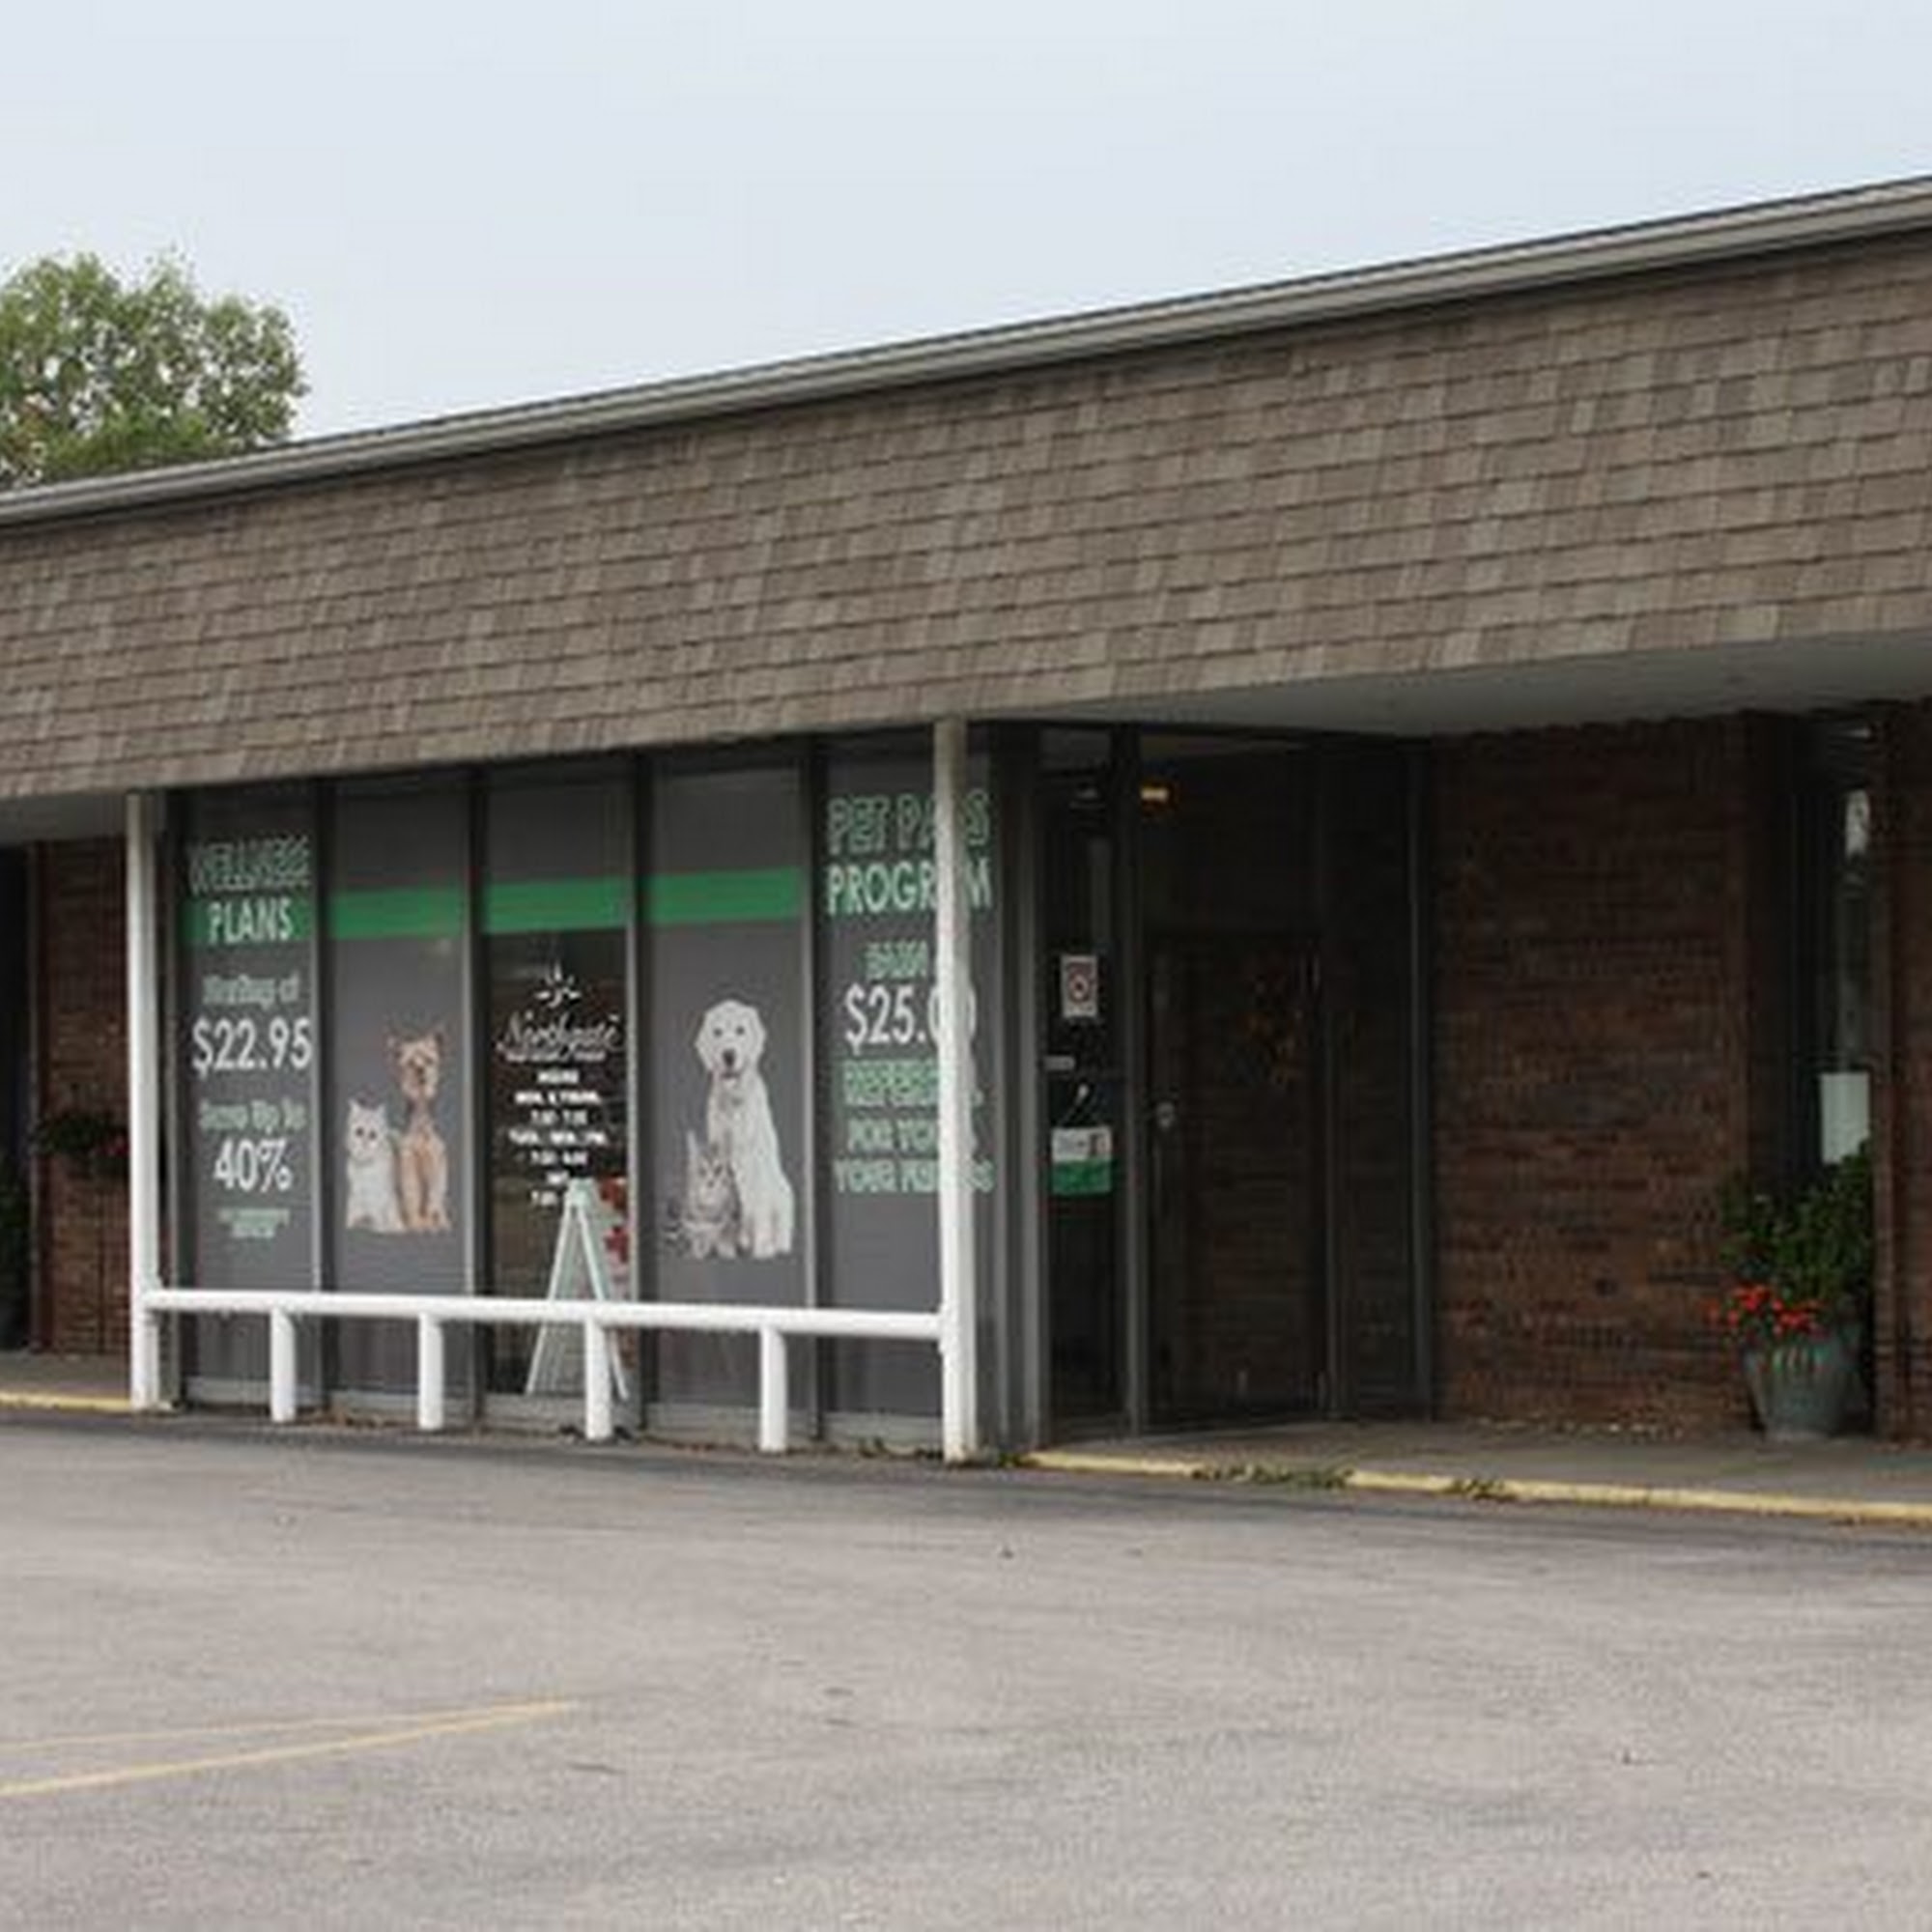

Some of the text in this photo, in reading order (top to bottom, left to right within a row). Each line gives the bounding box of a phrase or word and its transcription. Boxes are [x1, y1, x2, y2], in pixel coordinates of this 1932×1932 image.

[828, 789, 990, 855] PET PAS
[828, 858, 992, 916] PROGRM
[208, 895, 294, 946] PLANS
[193, 1017, 311, 1079] $22.95
[213, 1139, 293, 1193] 40%
